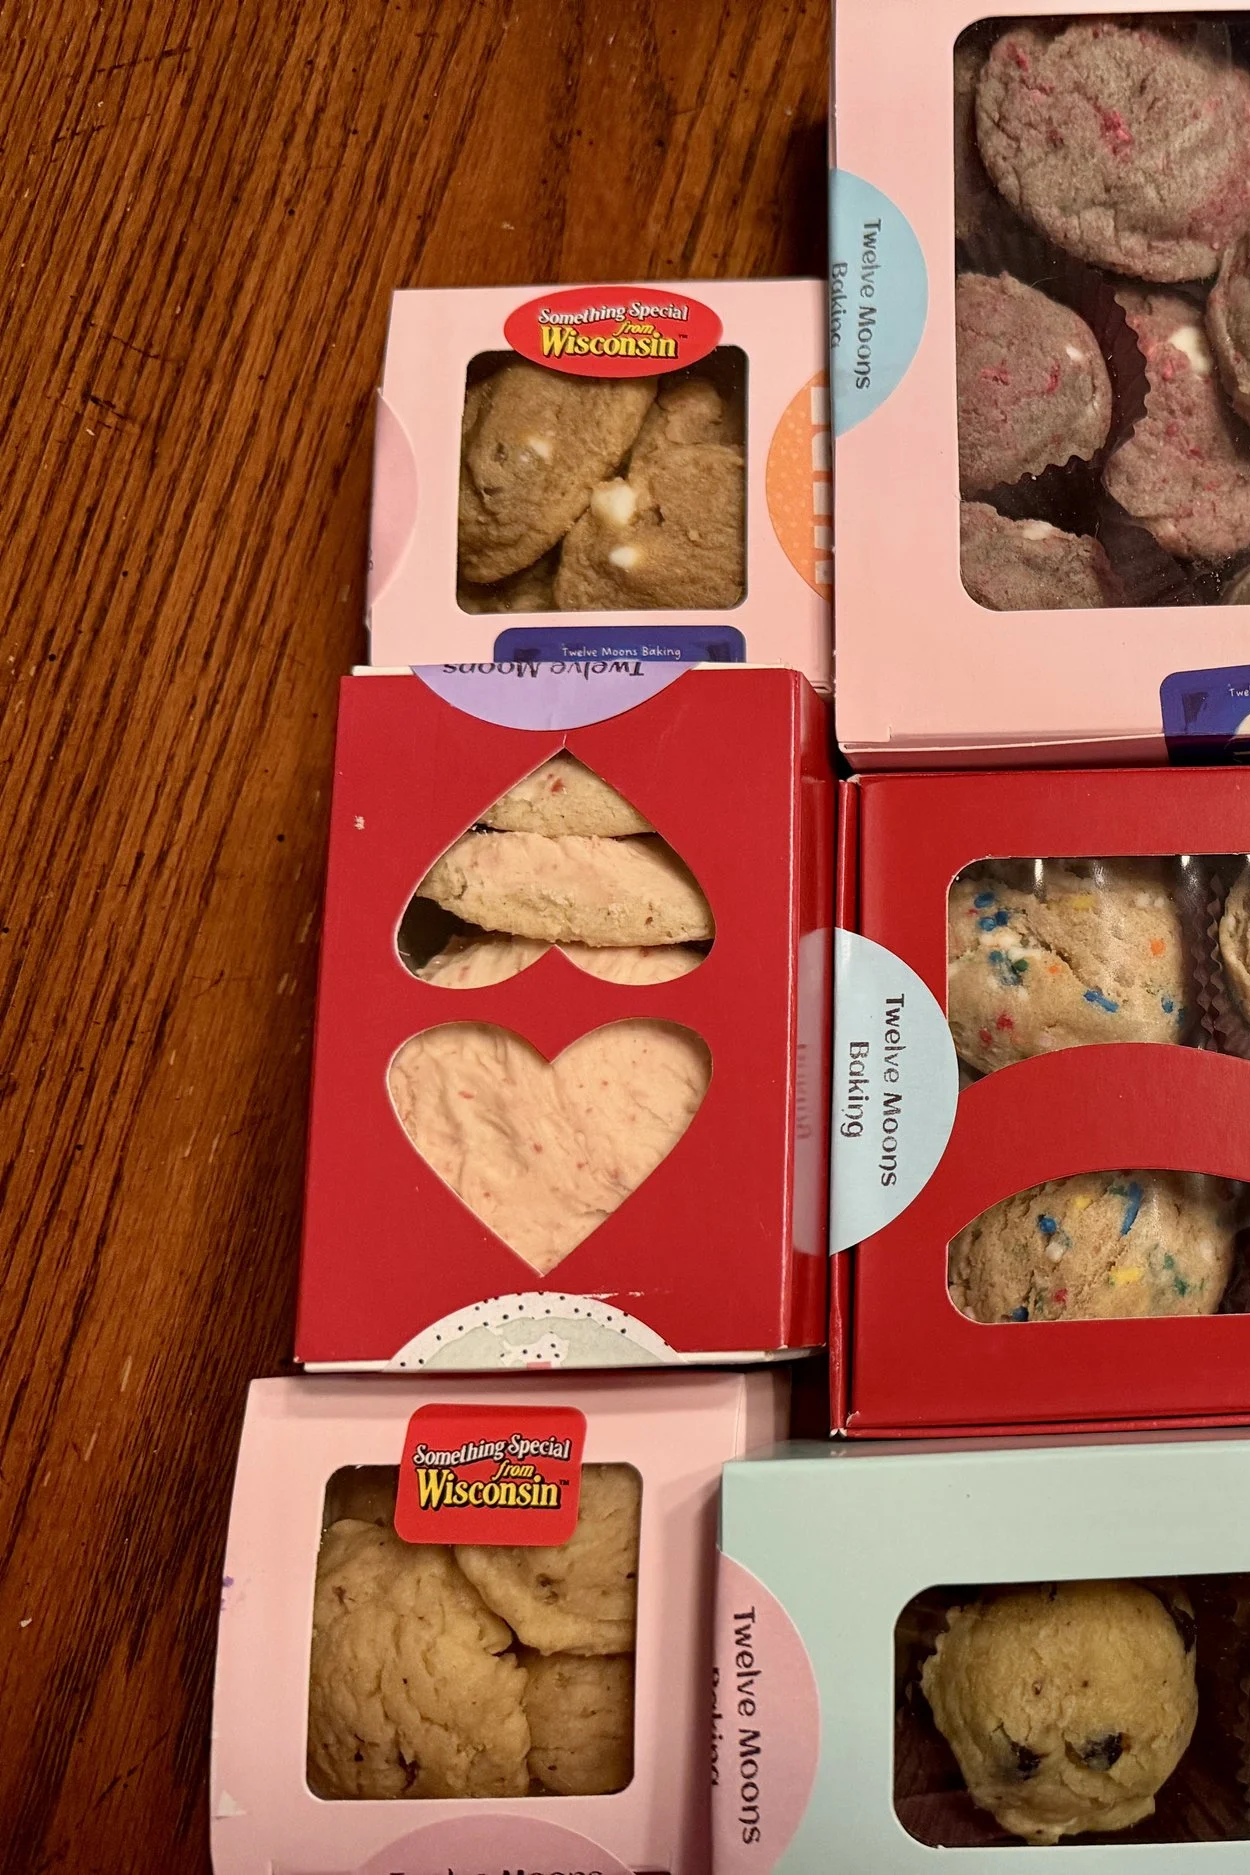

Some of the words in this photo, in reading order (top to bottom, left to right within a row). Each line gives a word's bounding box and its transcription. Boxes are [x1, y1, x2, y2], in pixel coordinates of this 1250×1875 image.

[859, 217, 882, 299] Twelve
[538, 305, 625, 325] Something
[629, 302, 688, 321] Special
[539, 325, 678, 359] Wisconsin
[613, 320, 654, 337] from
[855, 305, 878, 390] Moons
[561, 646, 598, 658] Twelve
[601, 646, 638, 658] Moons
[642, 646, 681, 660] Baking
[884, 993, 906, 1084] Twelve
[840, 1041, 869, 1138] Baking
[881, 1092, 903, 1187] Moons
[412, 1440, 507, 1467] Something
[507, 1433, 572, 1461] Special
[491, 1459, 536, 1482] from
[416, 1467, 562, 1511] Wisconsin
[733, 1606, 762, 1718] Twelve
[738, 1728, 761, 1846] Moons
